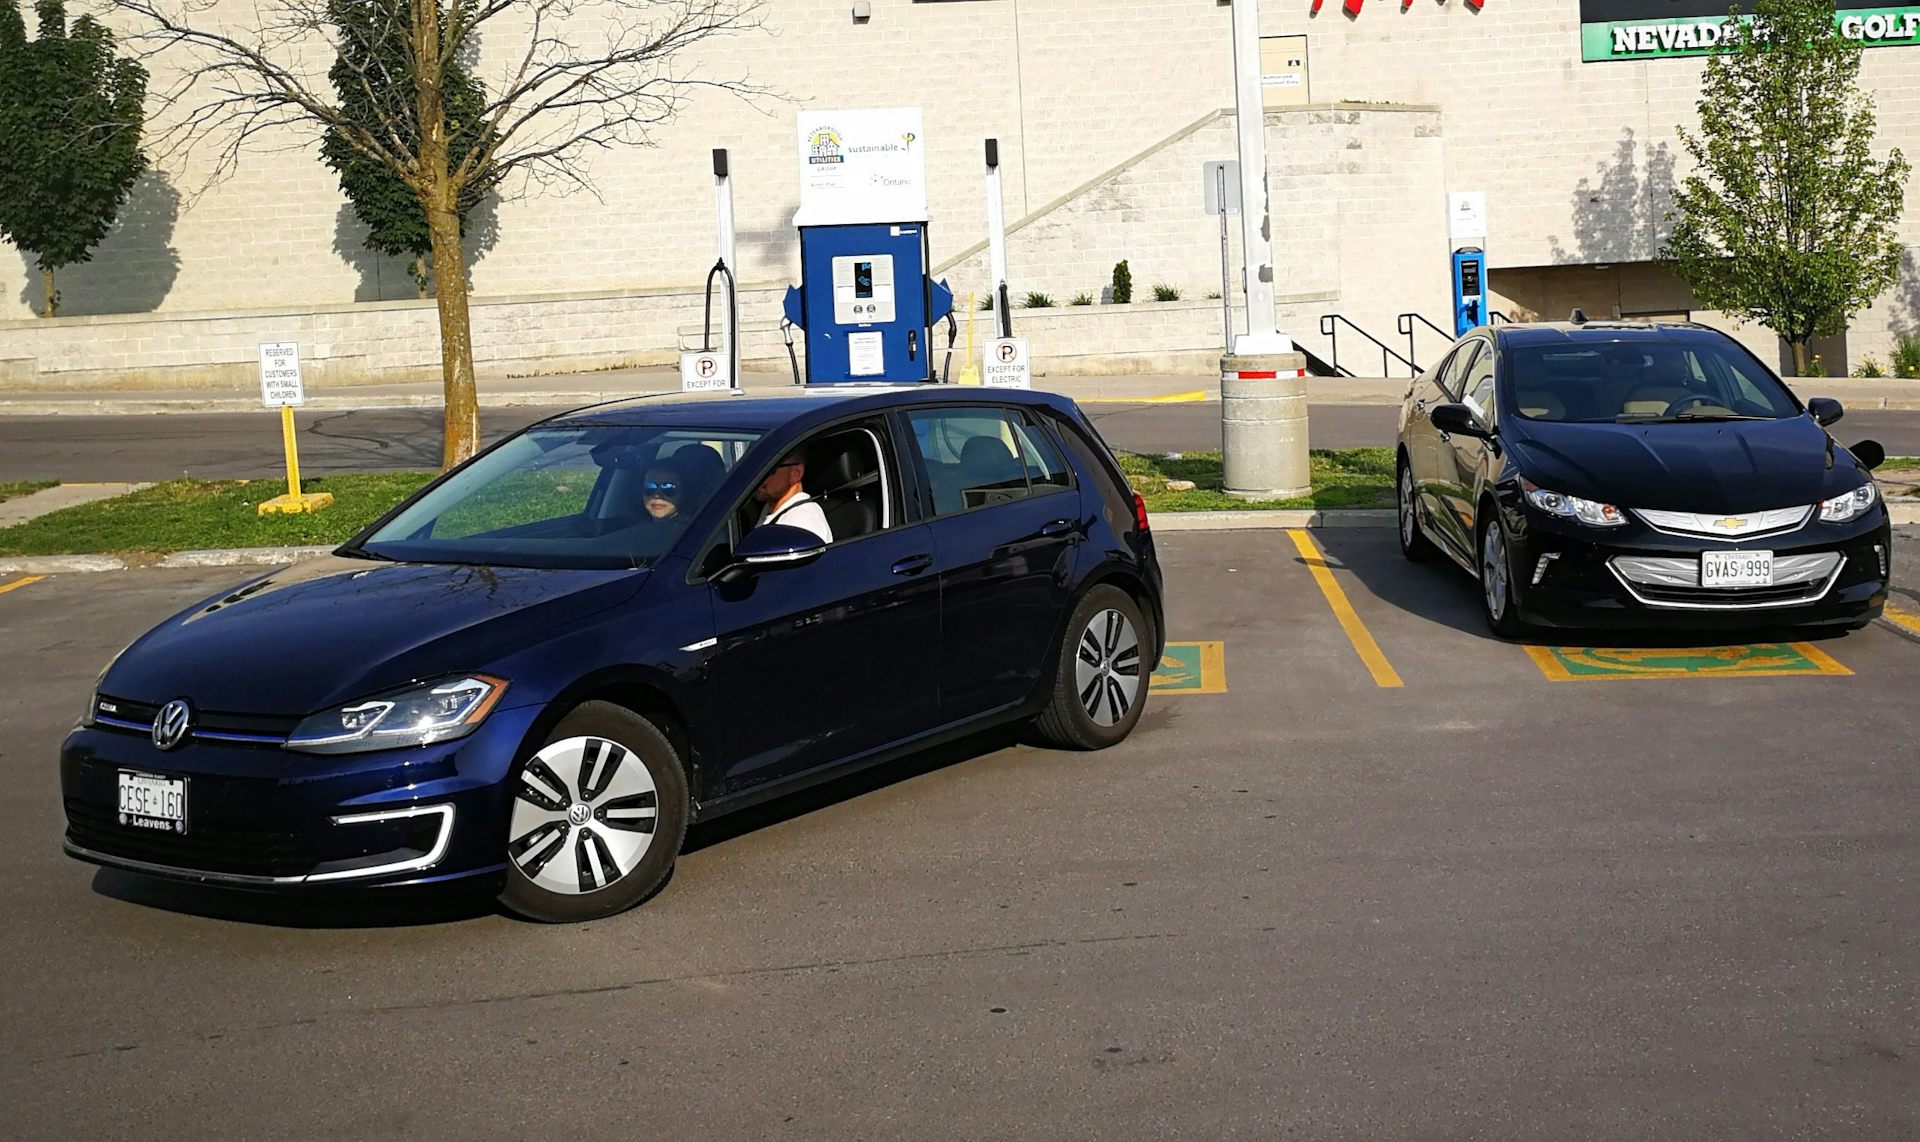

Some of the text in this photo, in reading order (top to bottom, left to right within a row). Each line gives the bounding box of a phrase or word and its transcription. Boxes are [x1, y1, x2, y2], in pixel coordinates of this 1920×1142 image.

[1841, 14, 1920, 40] GOLF
[848, 143, 898, 153] sustainable
[265, 347, 294, 357] RESERVED
[274, 359, 286, 367] FOR
[987, 364, 1025, 373] EXCEPT FOR
[264, 369, 298, 379] CUSTOMERS
[991, 375, 1022, 383] ELECTRIC
[266, 379, 298, 389] WITH SMALL
[687, 379, 726, 389] EXCEPT FOR
[270, 390, 297, 399] CHILDREN
[133, 814, 171, 831] Leavens
